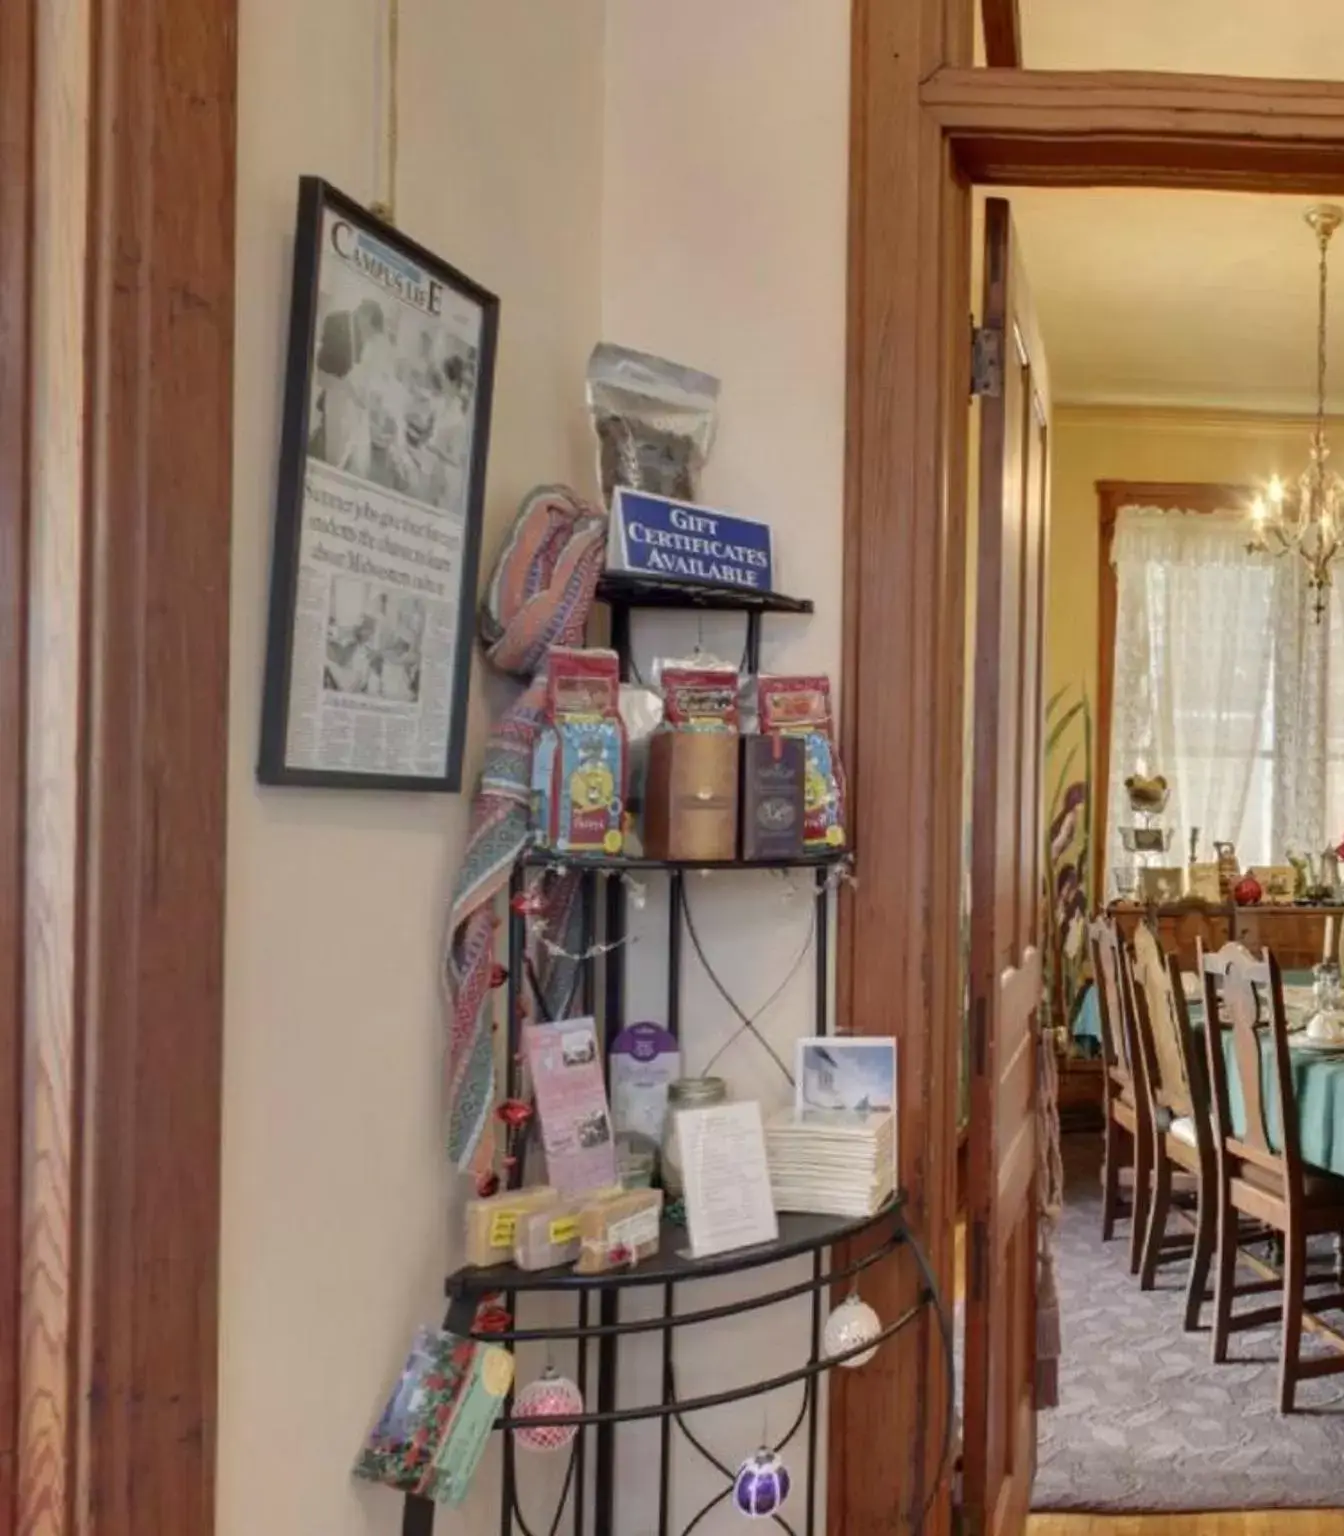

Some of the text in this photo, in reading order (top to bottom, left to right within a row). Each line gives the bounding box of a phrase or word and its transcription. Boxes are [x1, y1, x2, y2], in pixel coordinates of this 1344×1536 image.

[669, 507, 719, 536] GIFT
[628, 521, 768, 568] CERTIFICATES
[646, 547, 759, 588] AVAILABLE
